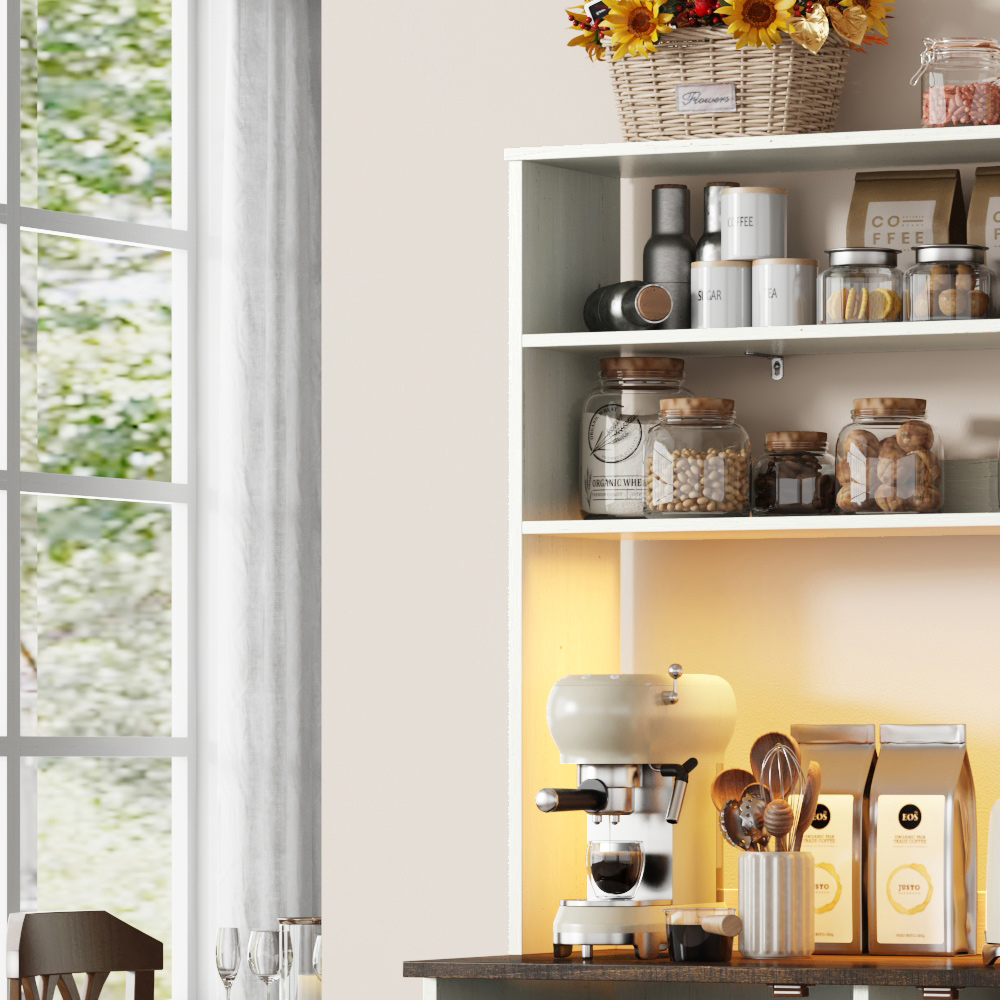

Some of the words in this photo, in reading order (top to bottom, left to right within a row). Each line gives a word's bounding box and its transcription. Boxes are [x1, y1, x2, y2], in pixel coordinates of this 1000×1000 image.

[682, 91, 730, 105] Flowers
[727, 216, 754, 227] CFFEE
[871, 215, 900, 228] CO
[873, 231, 925, 245] FFEE
[697, 290, 722, 302] SGAR
[623, 479, 642, 488] WHE
[902, 813, 919, 821] EOS
